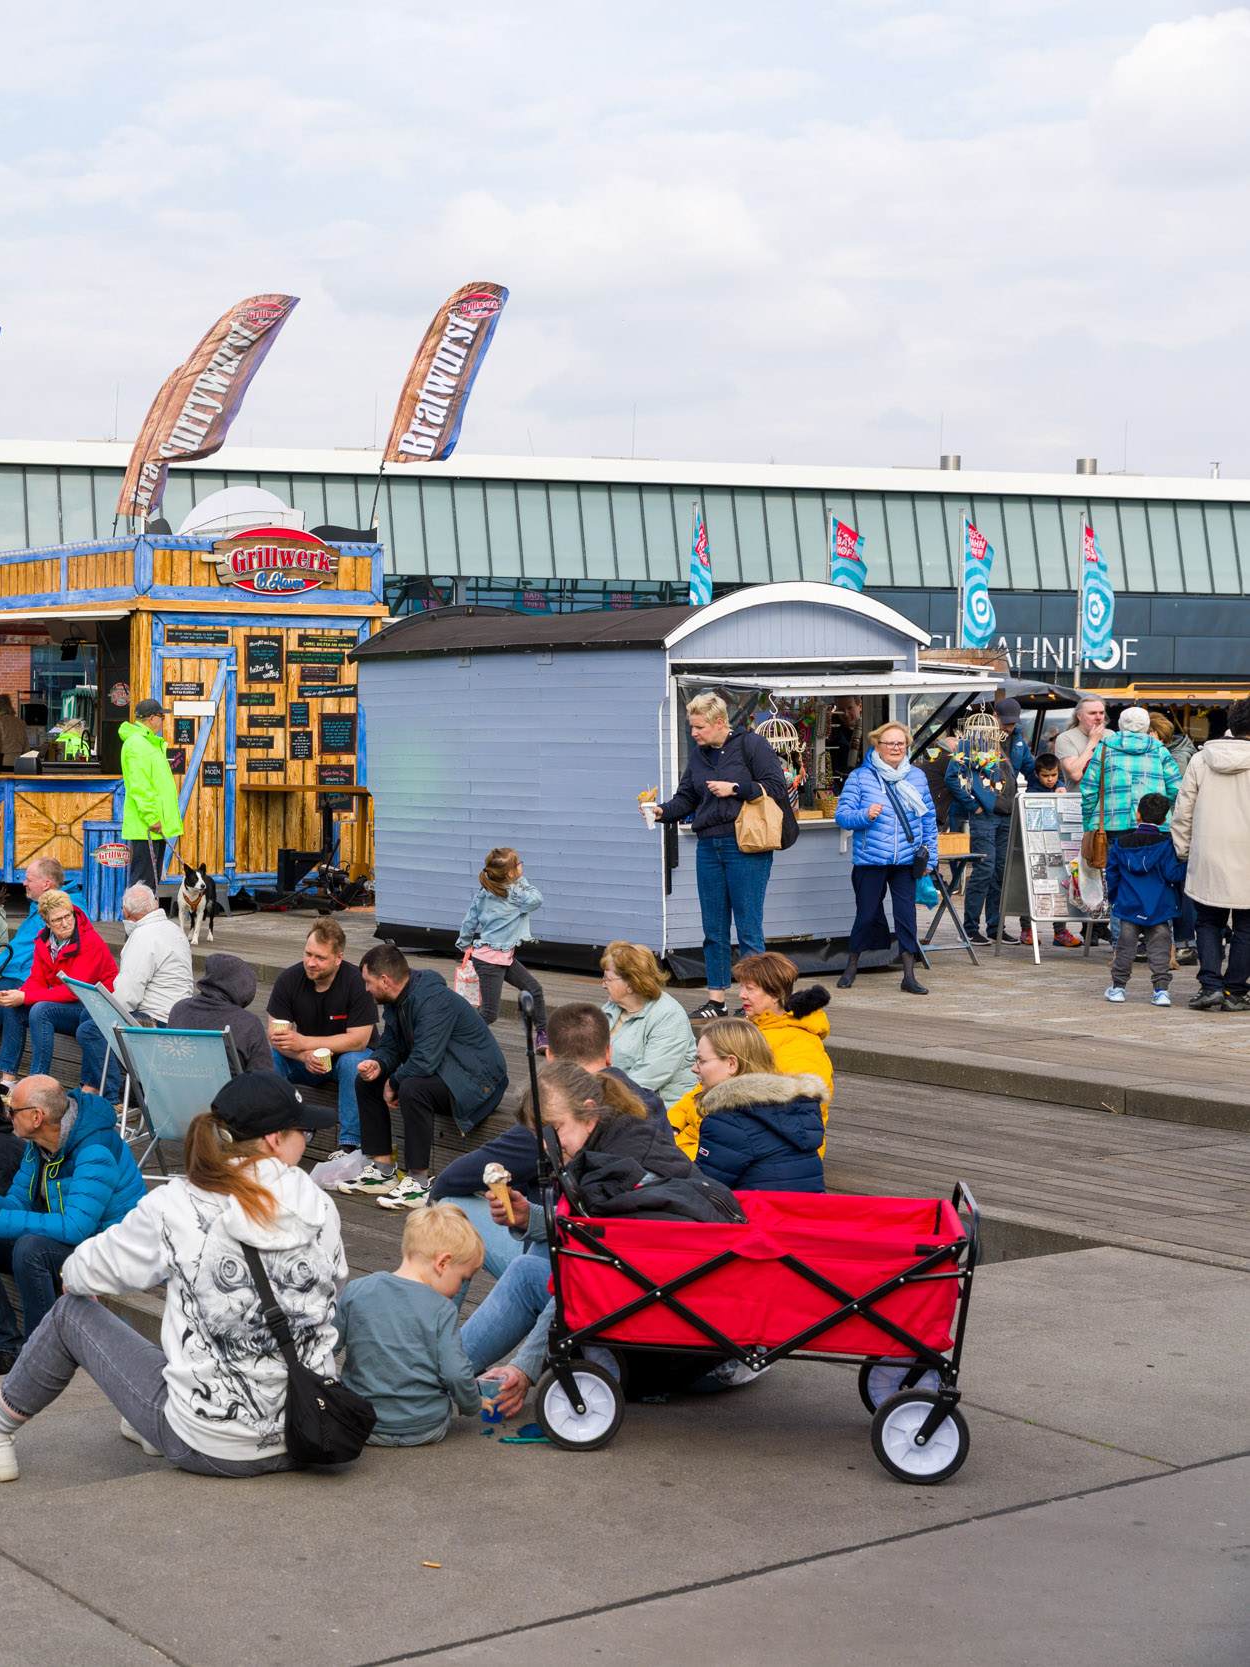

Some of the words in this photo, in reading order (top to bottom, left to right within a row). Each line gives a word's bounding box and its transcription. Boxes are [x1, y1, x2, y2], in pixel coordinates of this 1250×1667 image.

[460, 299, 499, 313] Grillwerk
[158, 320, 260, 459] Currywurst
[397, 312, 479, 457] Bratwurst
[231, 545, 331, 575] Grillwerk
